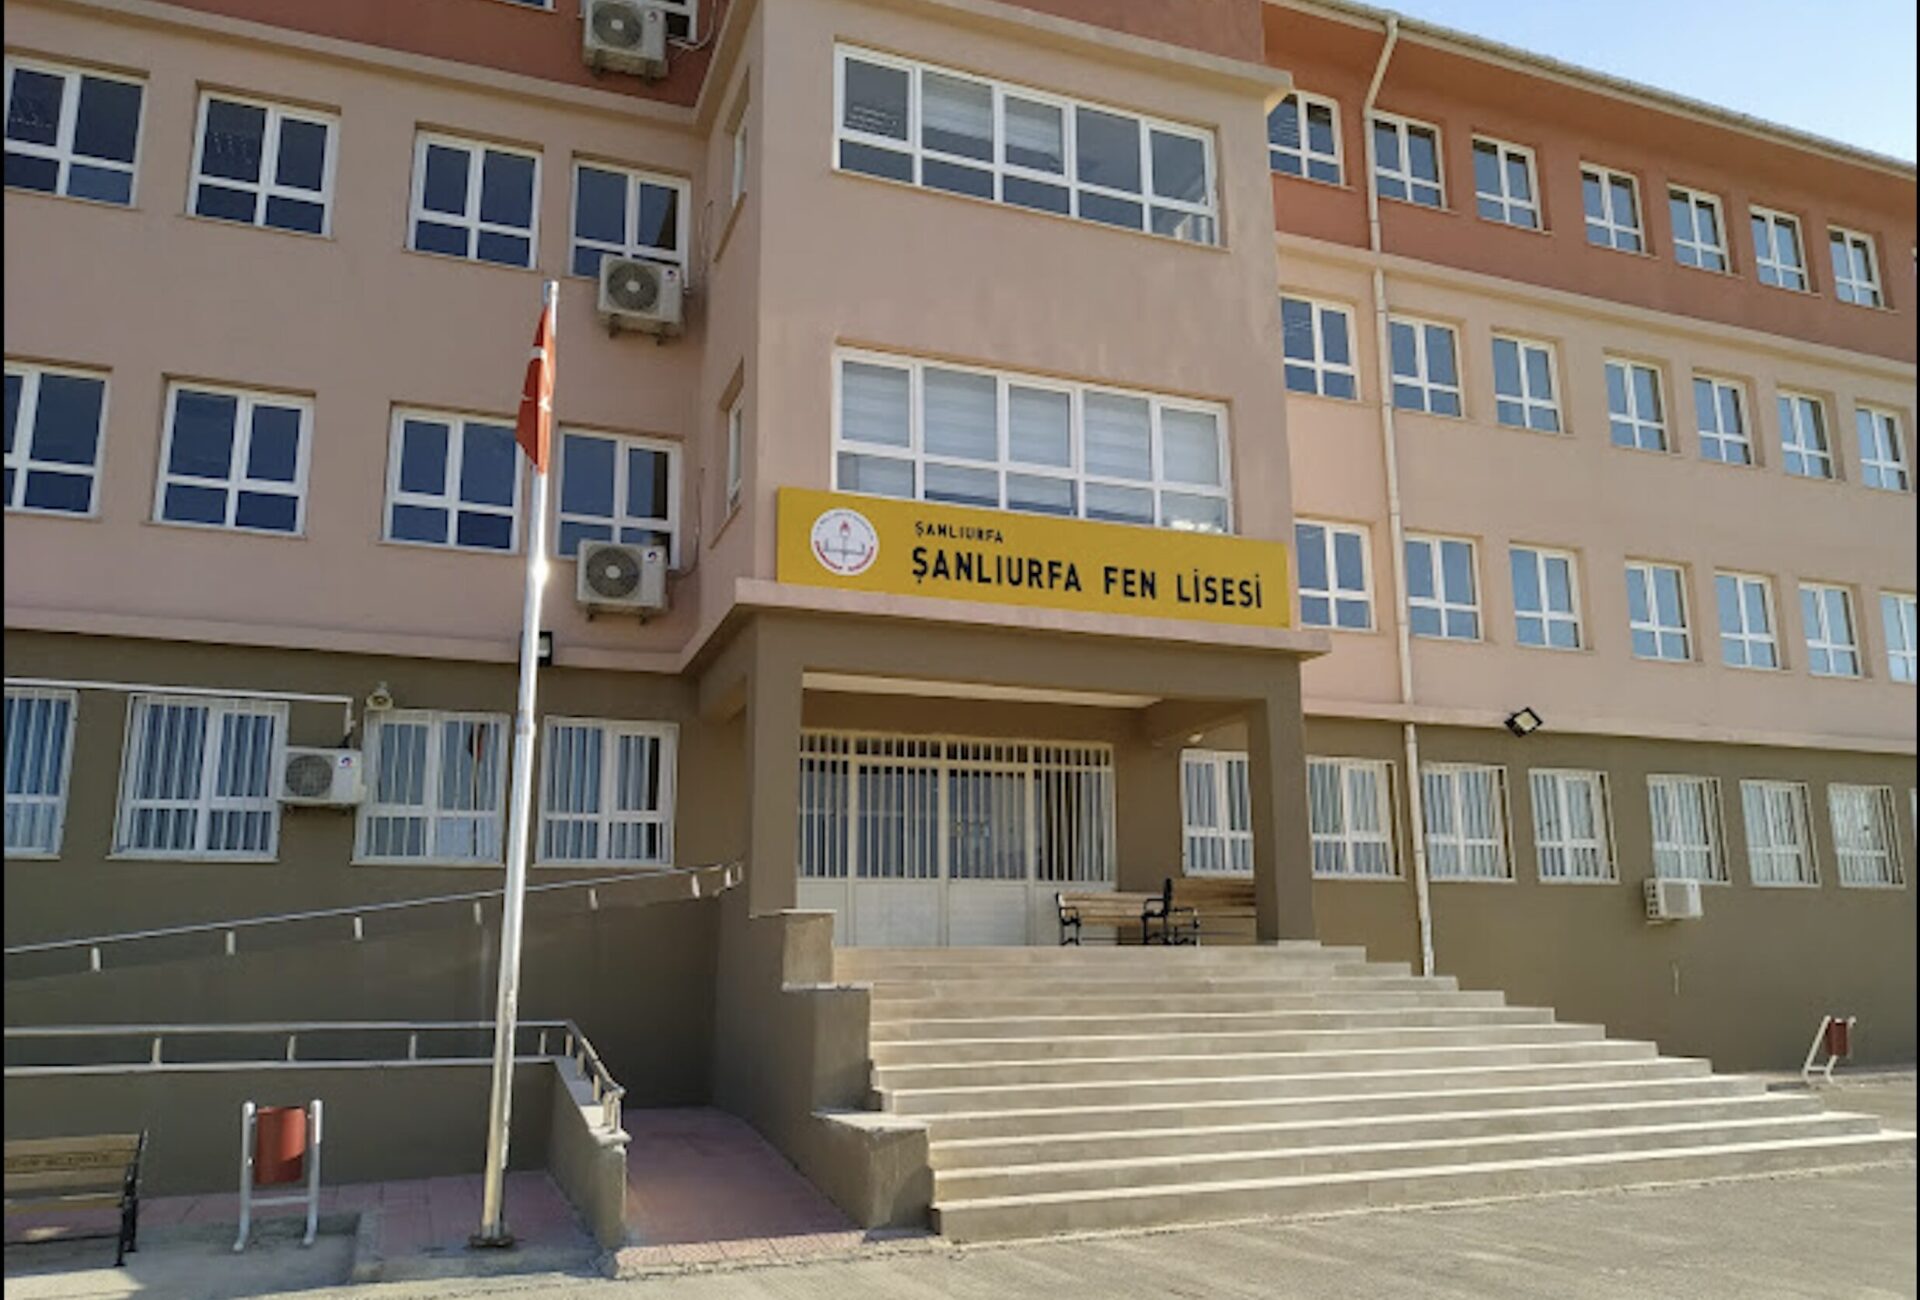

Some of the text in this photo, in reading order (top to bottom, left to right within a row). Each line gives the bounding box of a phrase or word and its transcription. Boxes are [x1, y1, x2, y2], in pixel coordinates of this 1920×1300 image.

[914, 520, 1004, 544] ŞANLIURFA
[911, 546, 1083, 594] ŞANLIURFA
[1103, 565, 1157, 602] FEN
[1176, 568, 1263, 610] LİSESİ
